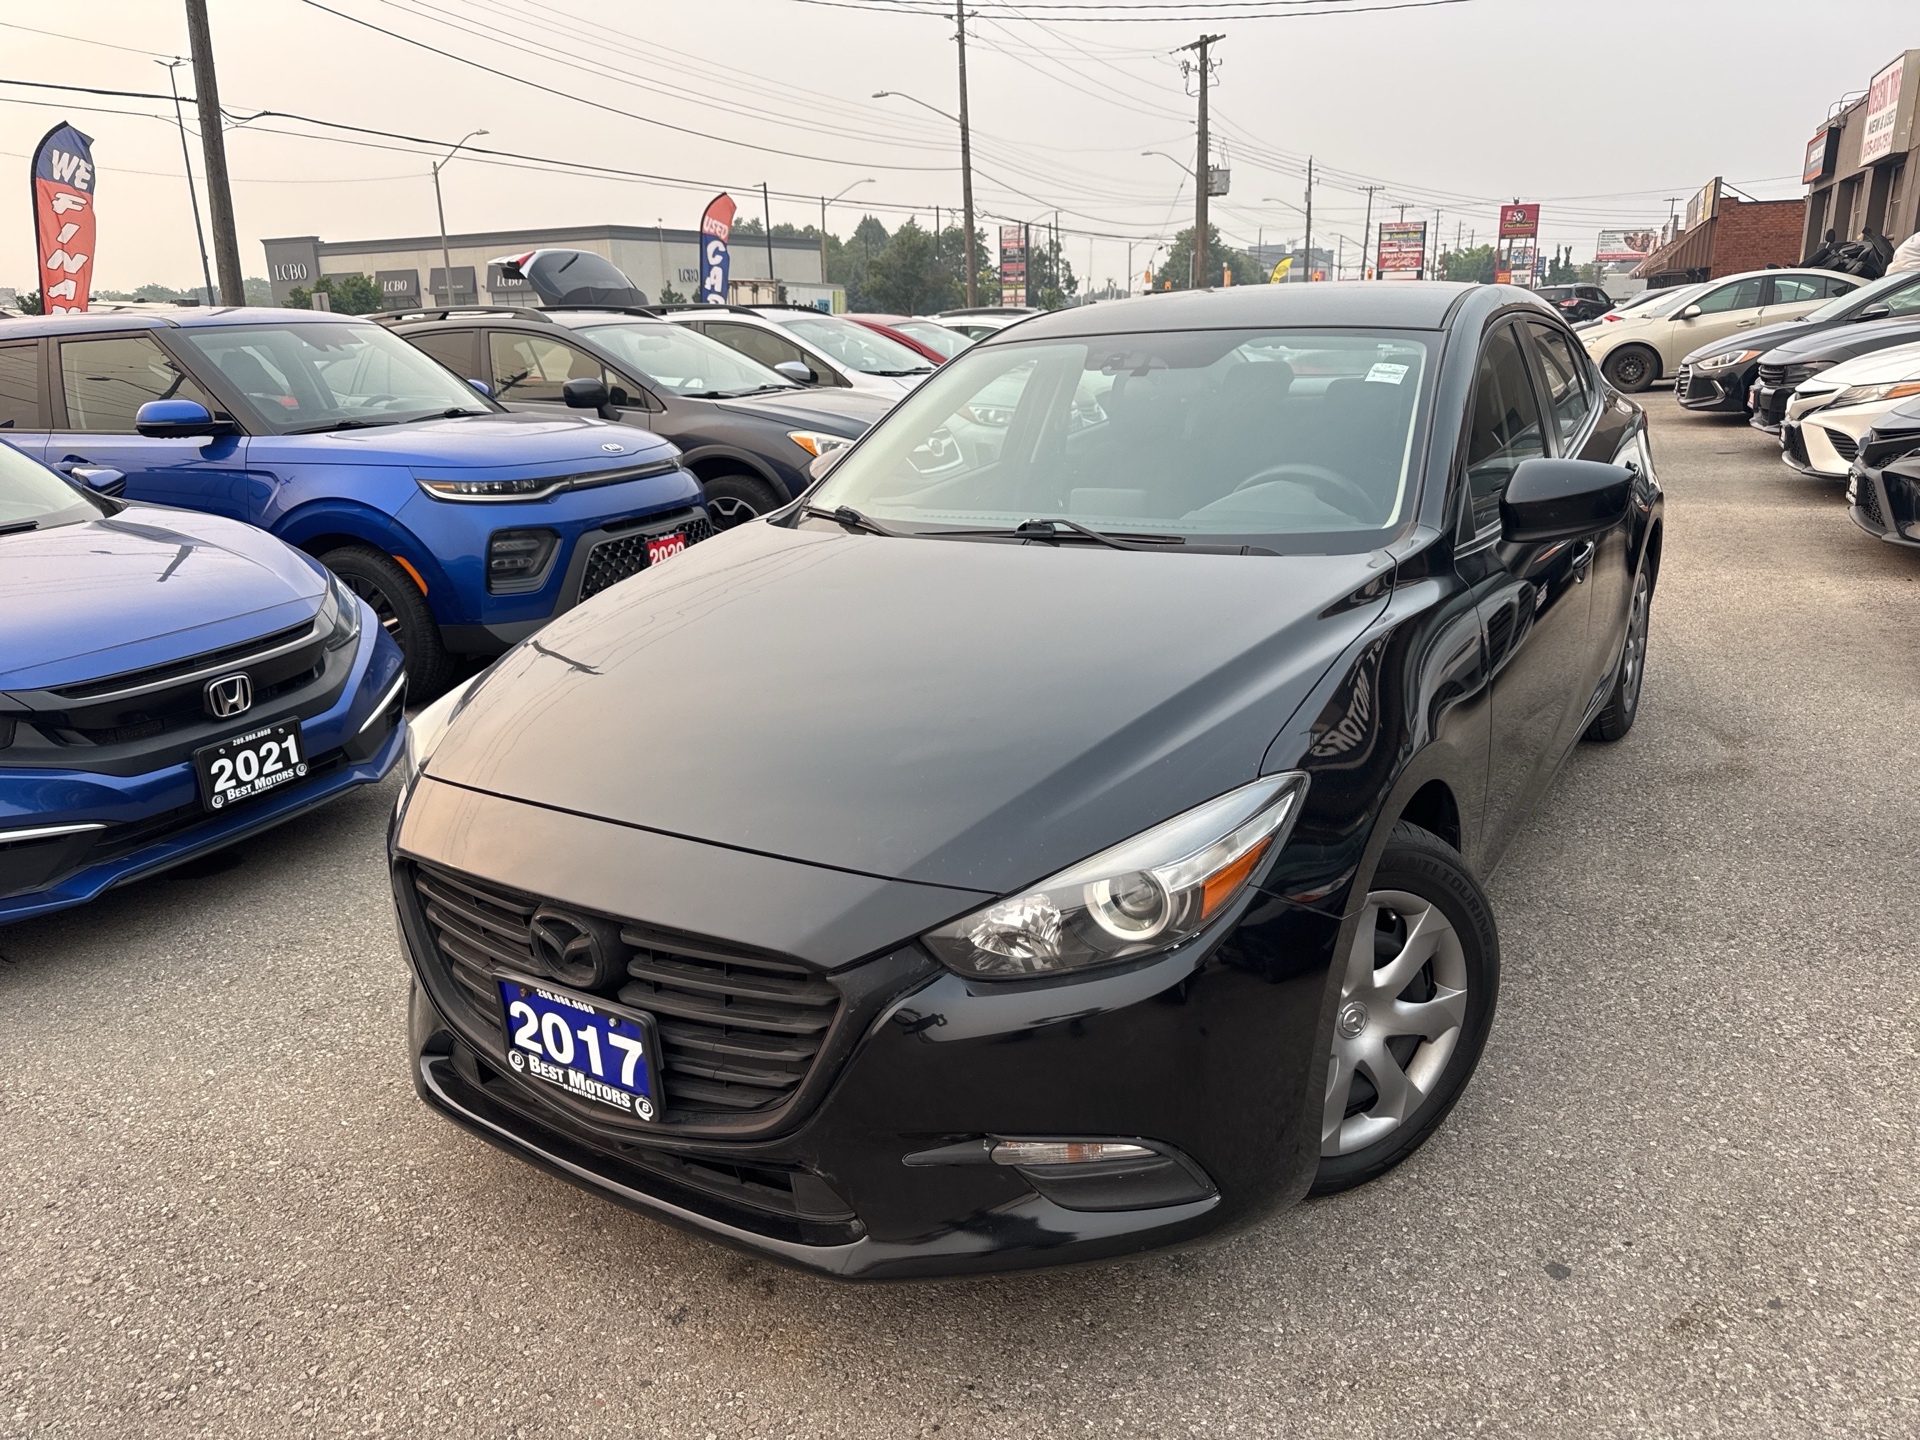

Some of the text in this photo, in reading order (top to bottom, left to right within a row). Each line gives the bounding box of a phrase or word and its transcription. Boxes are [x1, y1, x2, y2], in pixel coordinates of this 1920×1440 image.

[52, 149, 93, 190] WE
[703, 215, 729, 239] USED
[274, 262, 308, 281] LCBO
[383, 279, 407, 292] LCBO
[678, 268, 699, 282] LCBO
[210, 734, 299, 793] 2021
[226, 768, 294, 800] BEST MOTORS
[1440, 868, 1492, 947] TOURING
[509, 1000, 643, 1087] 2017
[528, 1054, 631, 1108] BEST MOTORS
[563, 1084, 597, 1101] Hamilton
